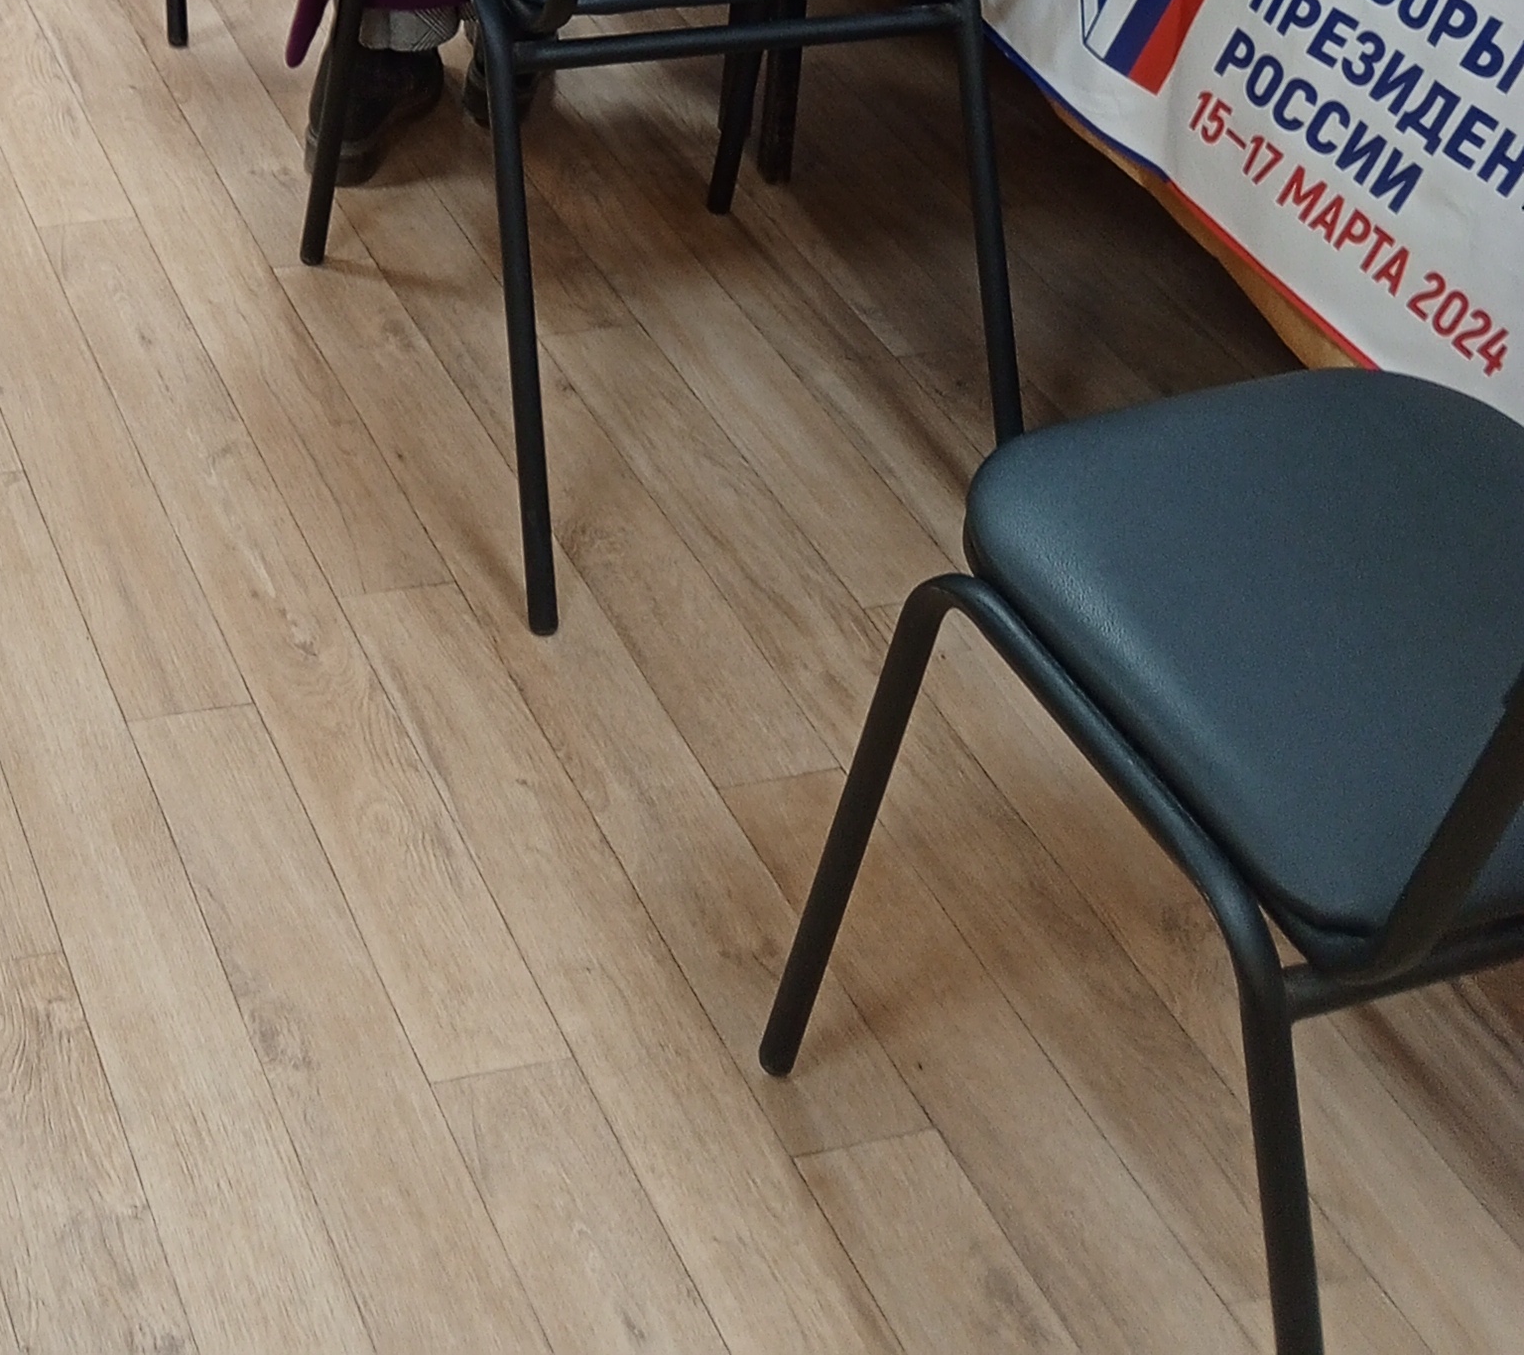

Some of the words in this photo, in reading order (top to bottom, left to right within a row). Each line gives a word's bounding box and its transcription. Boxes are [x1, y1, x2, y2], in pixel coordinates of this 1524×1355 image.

[1213, 27, 1424, 215] РОССИИ
[1276, 164, 1407, 297] МАРТА
[1407, 271, 1509, 377] 2024
